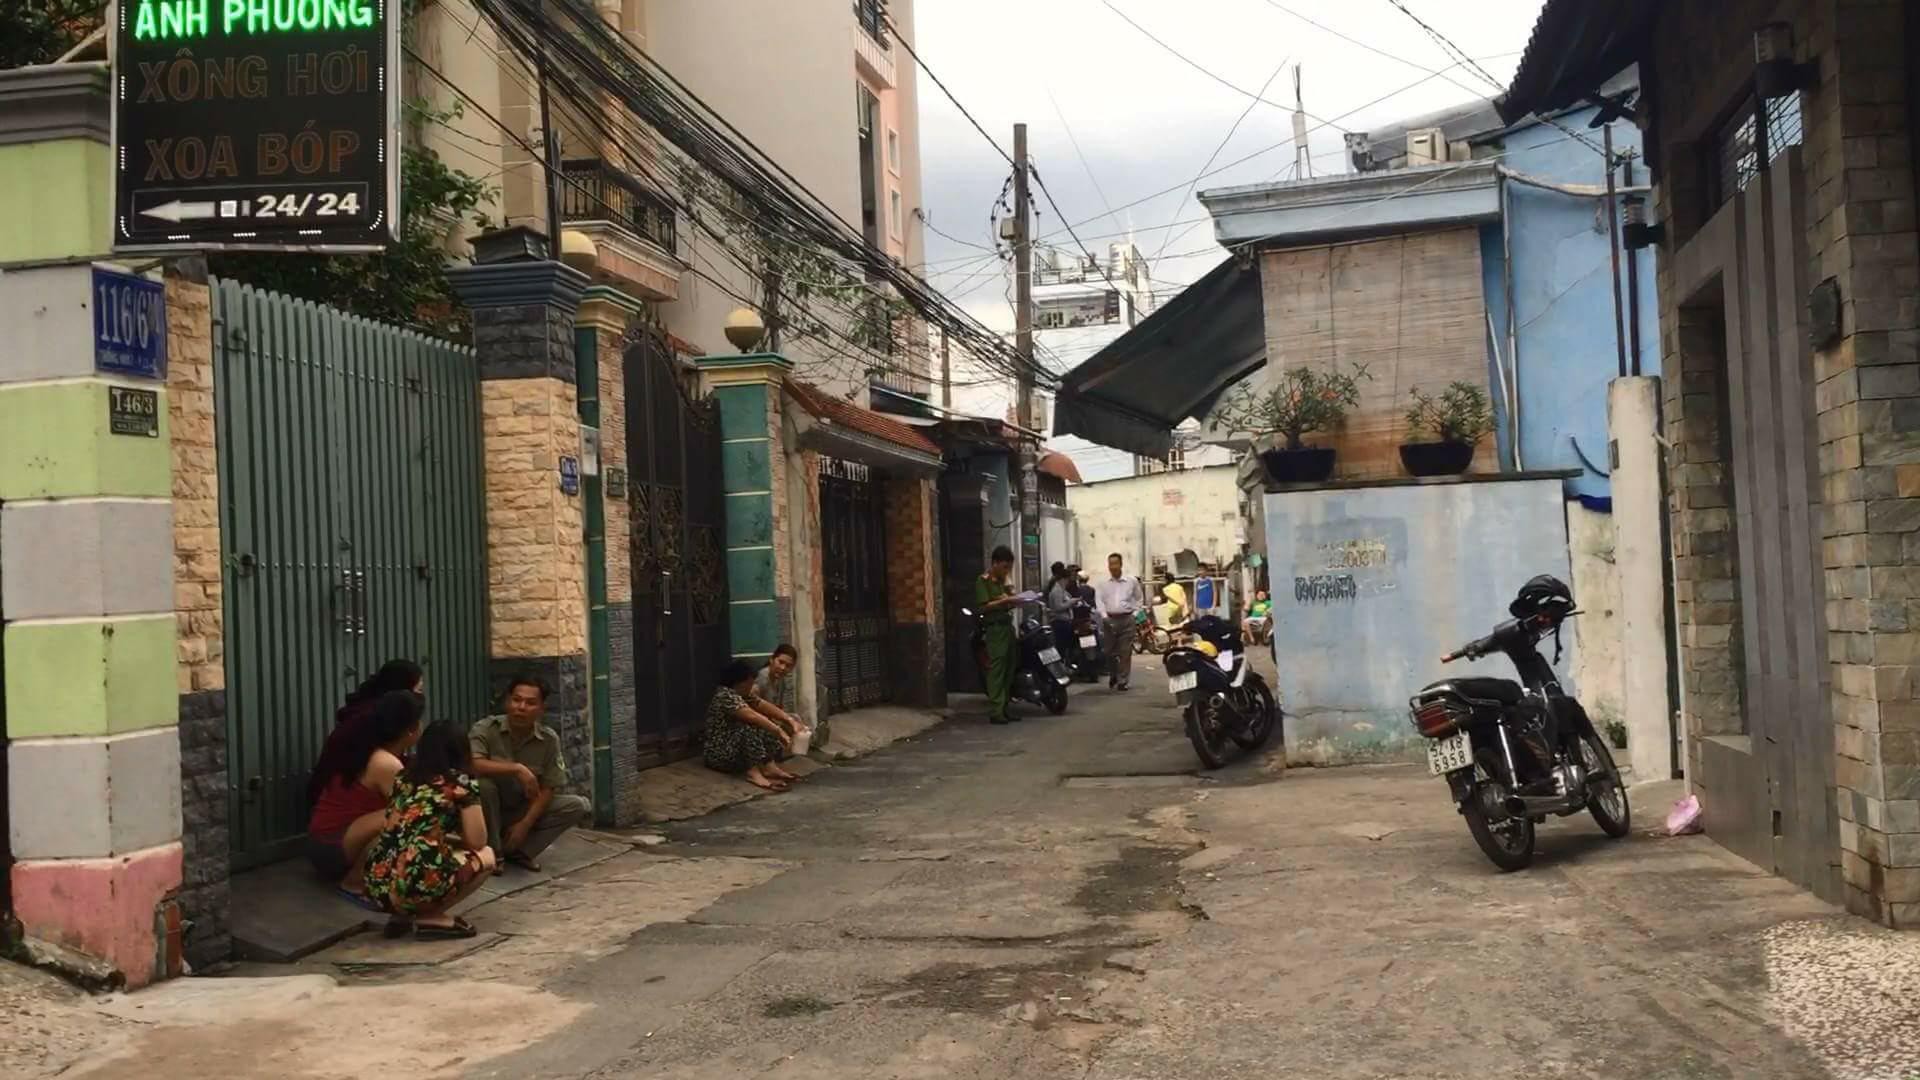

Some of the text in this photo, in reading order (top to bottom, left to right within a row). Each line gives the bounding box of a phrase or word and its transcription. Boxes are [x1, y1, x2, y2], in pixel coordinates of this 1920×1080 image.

[136, 44, 368, 103] XÔNG HƠI
[144, 120, 360, 181] XOA BÓP
